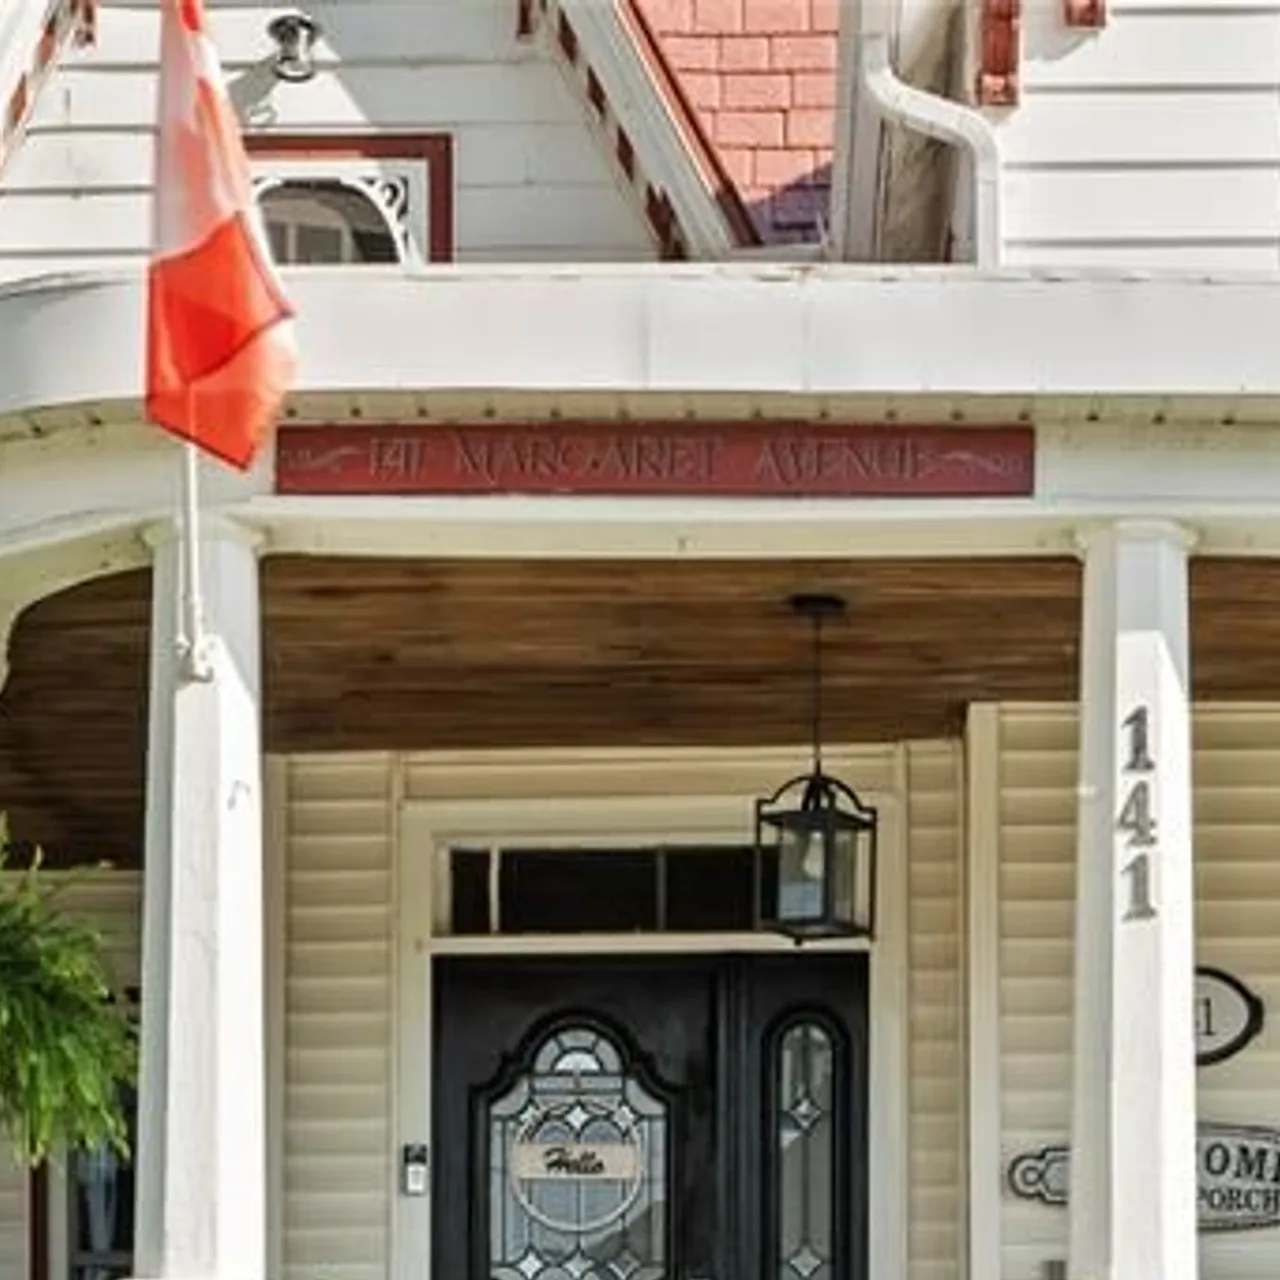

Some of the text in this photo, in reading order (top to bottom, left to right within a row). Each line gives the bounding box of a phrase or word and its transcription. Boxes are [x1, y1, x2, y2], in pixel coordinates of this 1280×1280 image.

[452, 435, 720, 485] MARGARET
[756, 435, 928, 486] AVENUE
[1116, 705, 1159, 923] 141
[543, 1146, 605, 1175] Hello
